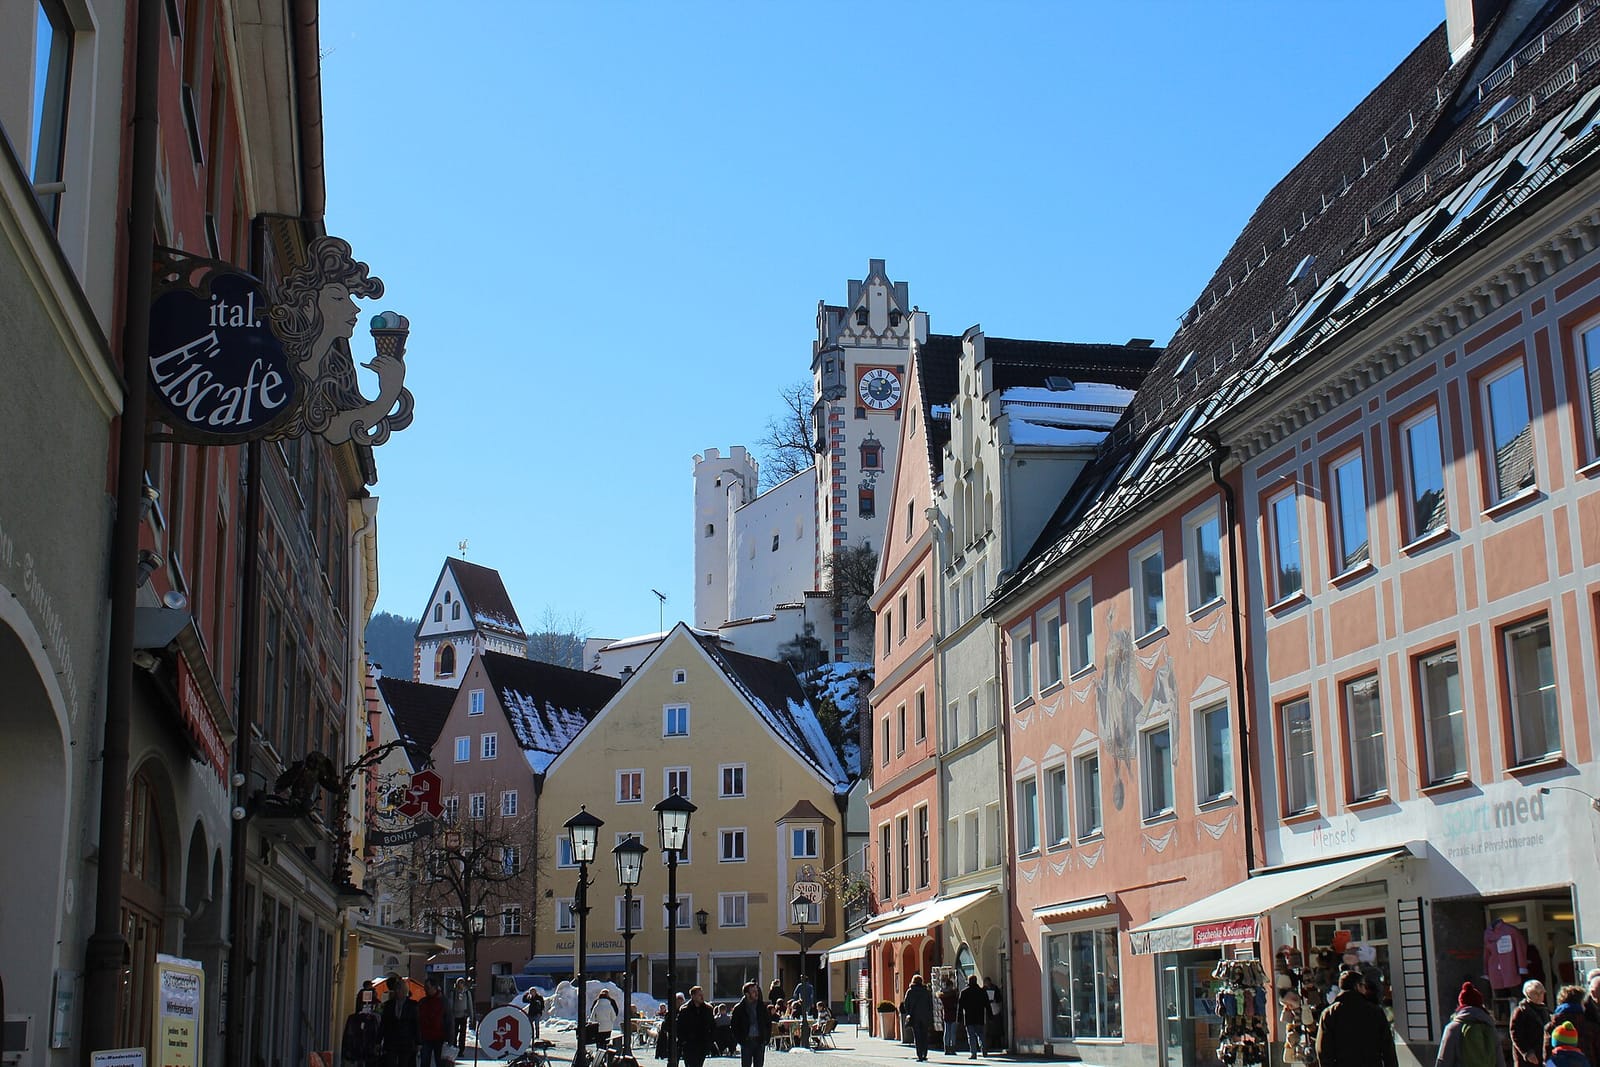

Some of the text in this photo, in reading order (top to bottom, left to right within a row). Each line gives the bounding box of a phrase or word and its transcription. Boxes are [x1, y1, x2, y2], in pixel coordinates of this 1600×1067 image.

[208, 292, 261, 328] ital.
[149, 329, 287, 427] Eiscafé
[1443, 789, 1545, 842] sport med
[1484, 833, 1544, 854] Physiotherapie
[592, 940, 624, 949] KUHSTALL
[1196, 929, 1222, 941] Geschenke
[1228, 924, 1253, 937] Souvenirs
